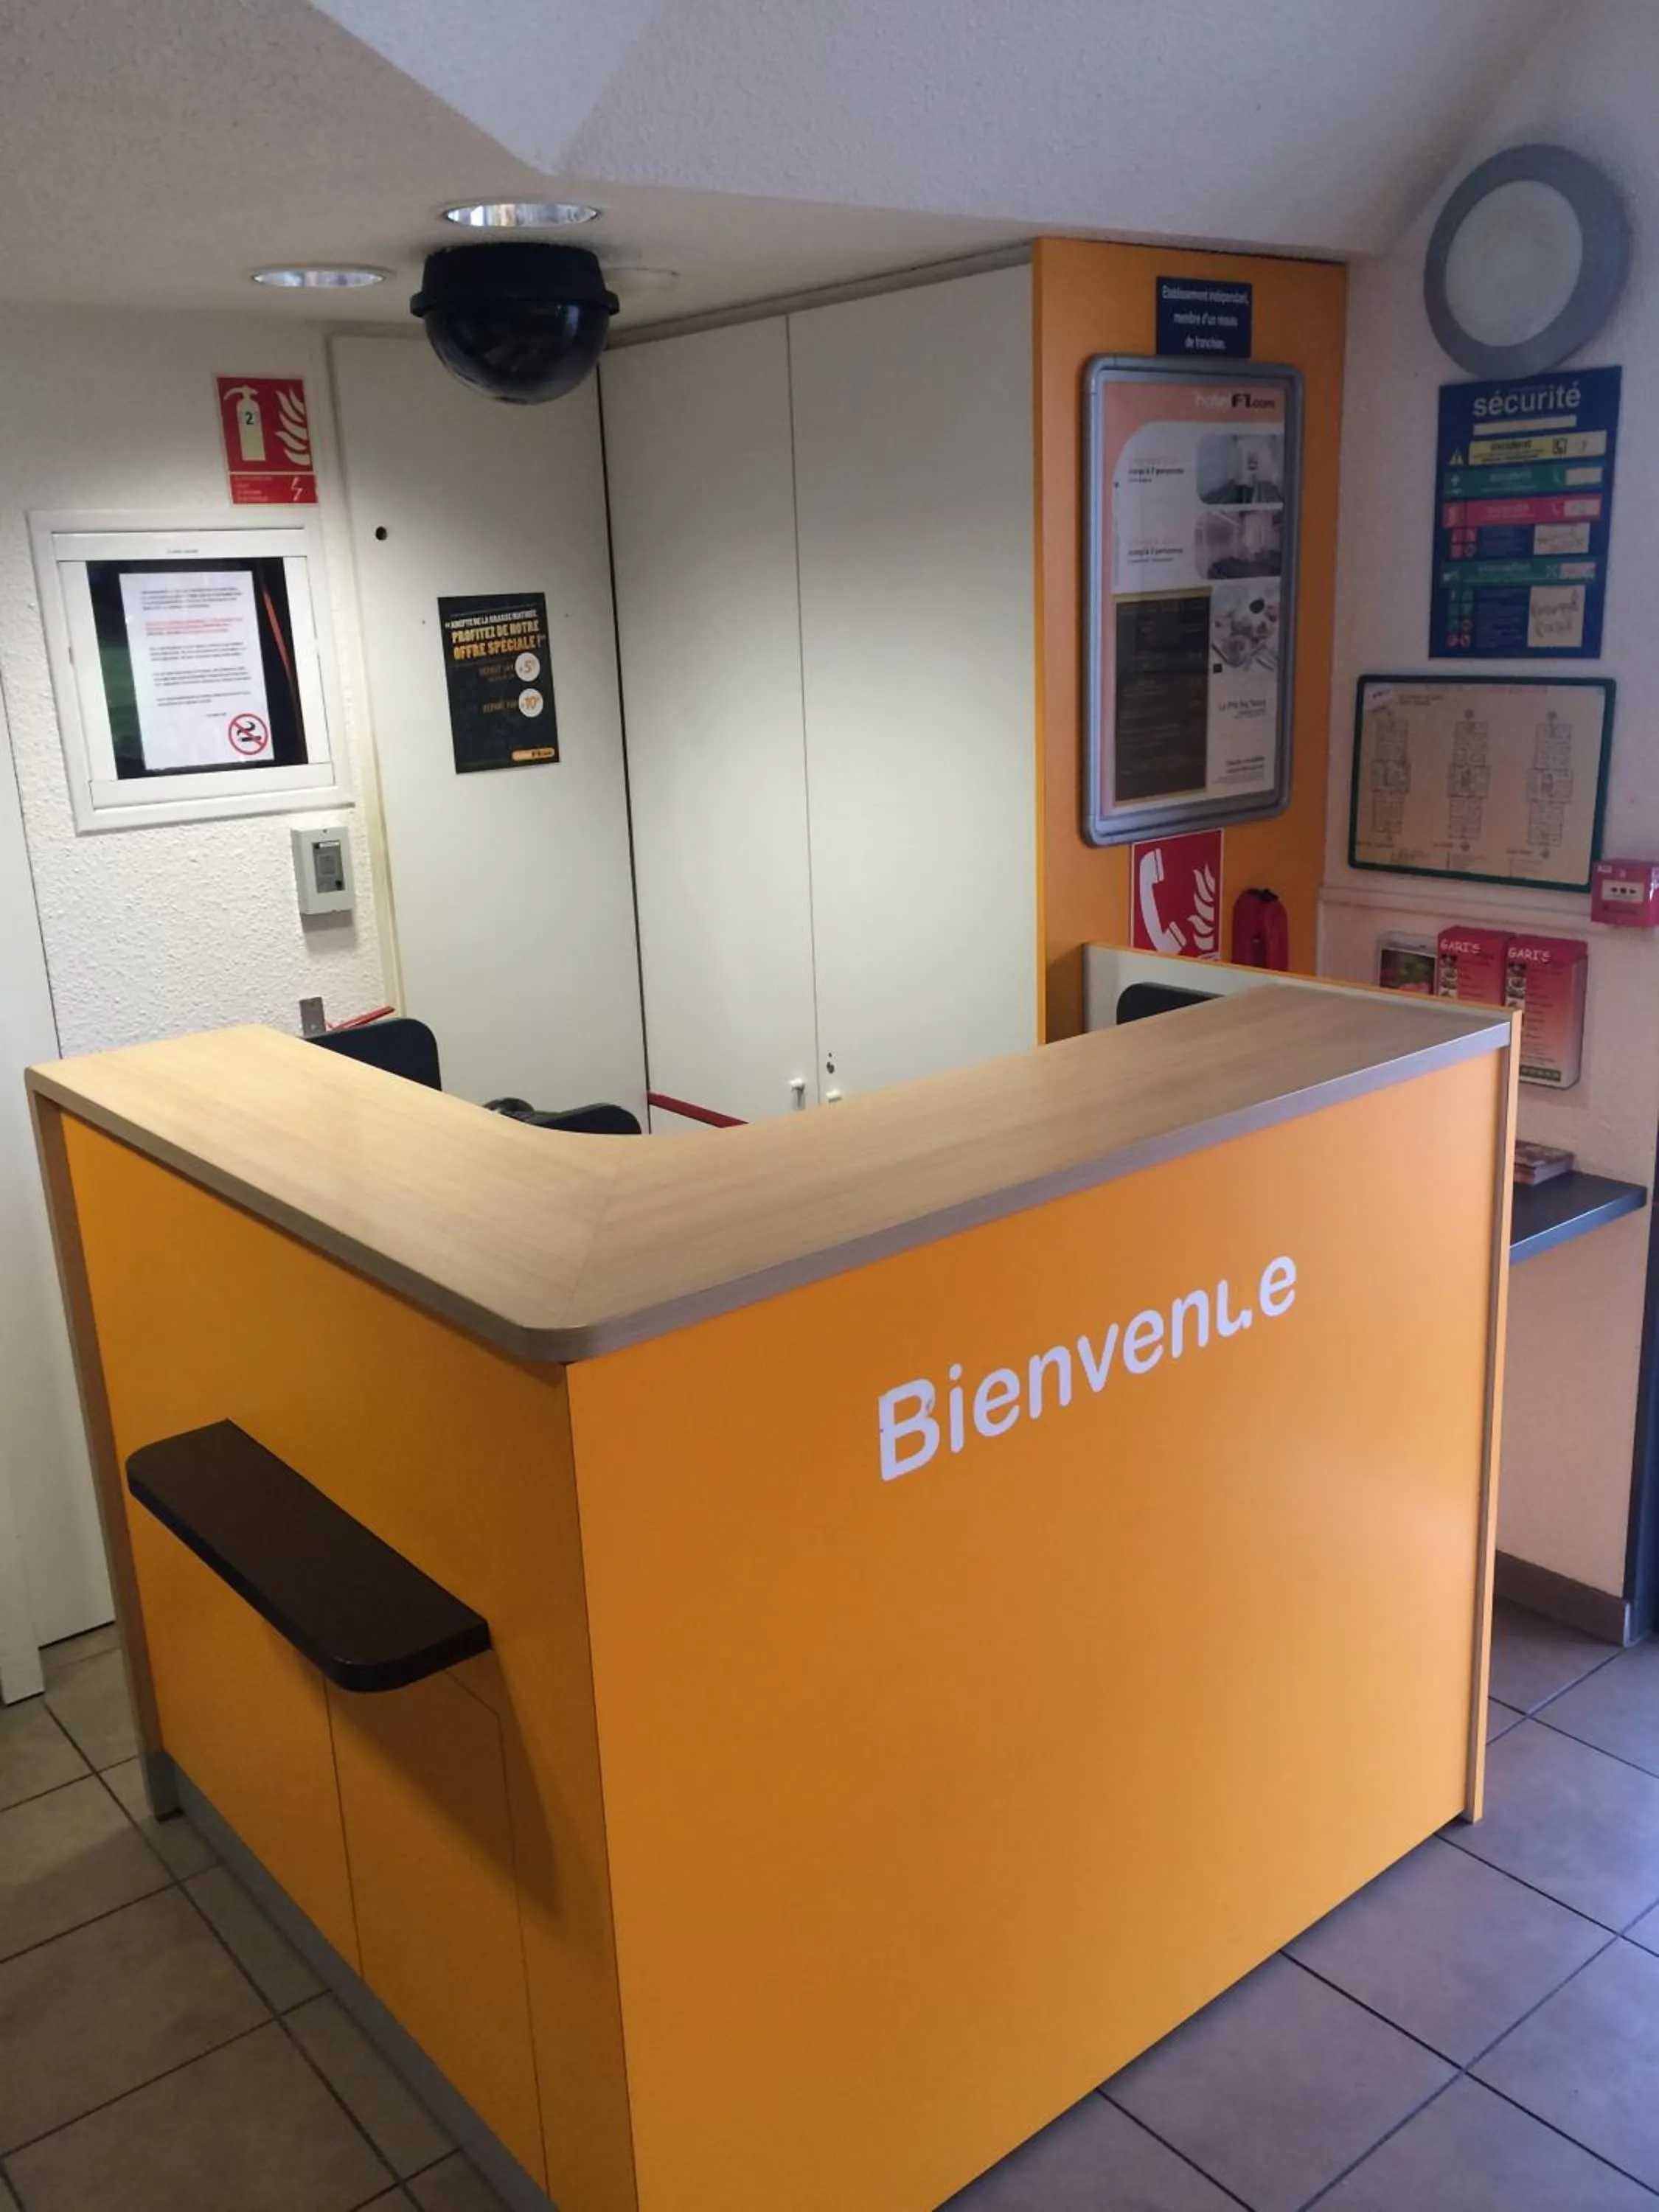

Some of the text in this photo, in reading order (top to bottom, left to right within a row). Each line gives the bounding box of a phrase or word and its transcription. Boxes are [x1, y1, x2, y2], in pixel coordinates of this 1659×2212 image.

[1472, 380, 1582, 417] sécurité
[245, 411, 254, 425] 2
[451, 619, 540, 644] PROFITEZ DE NOTRE
[453, 641, 487, 661] OFFRE
[878, 1255, 1297, 1482] Bienvenue
